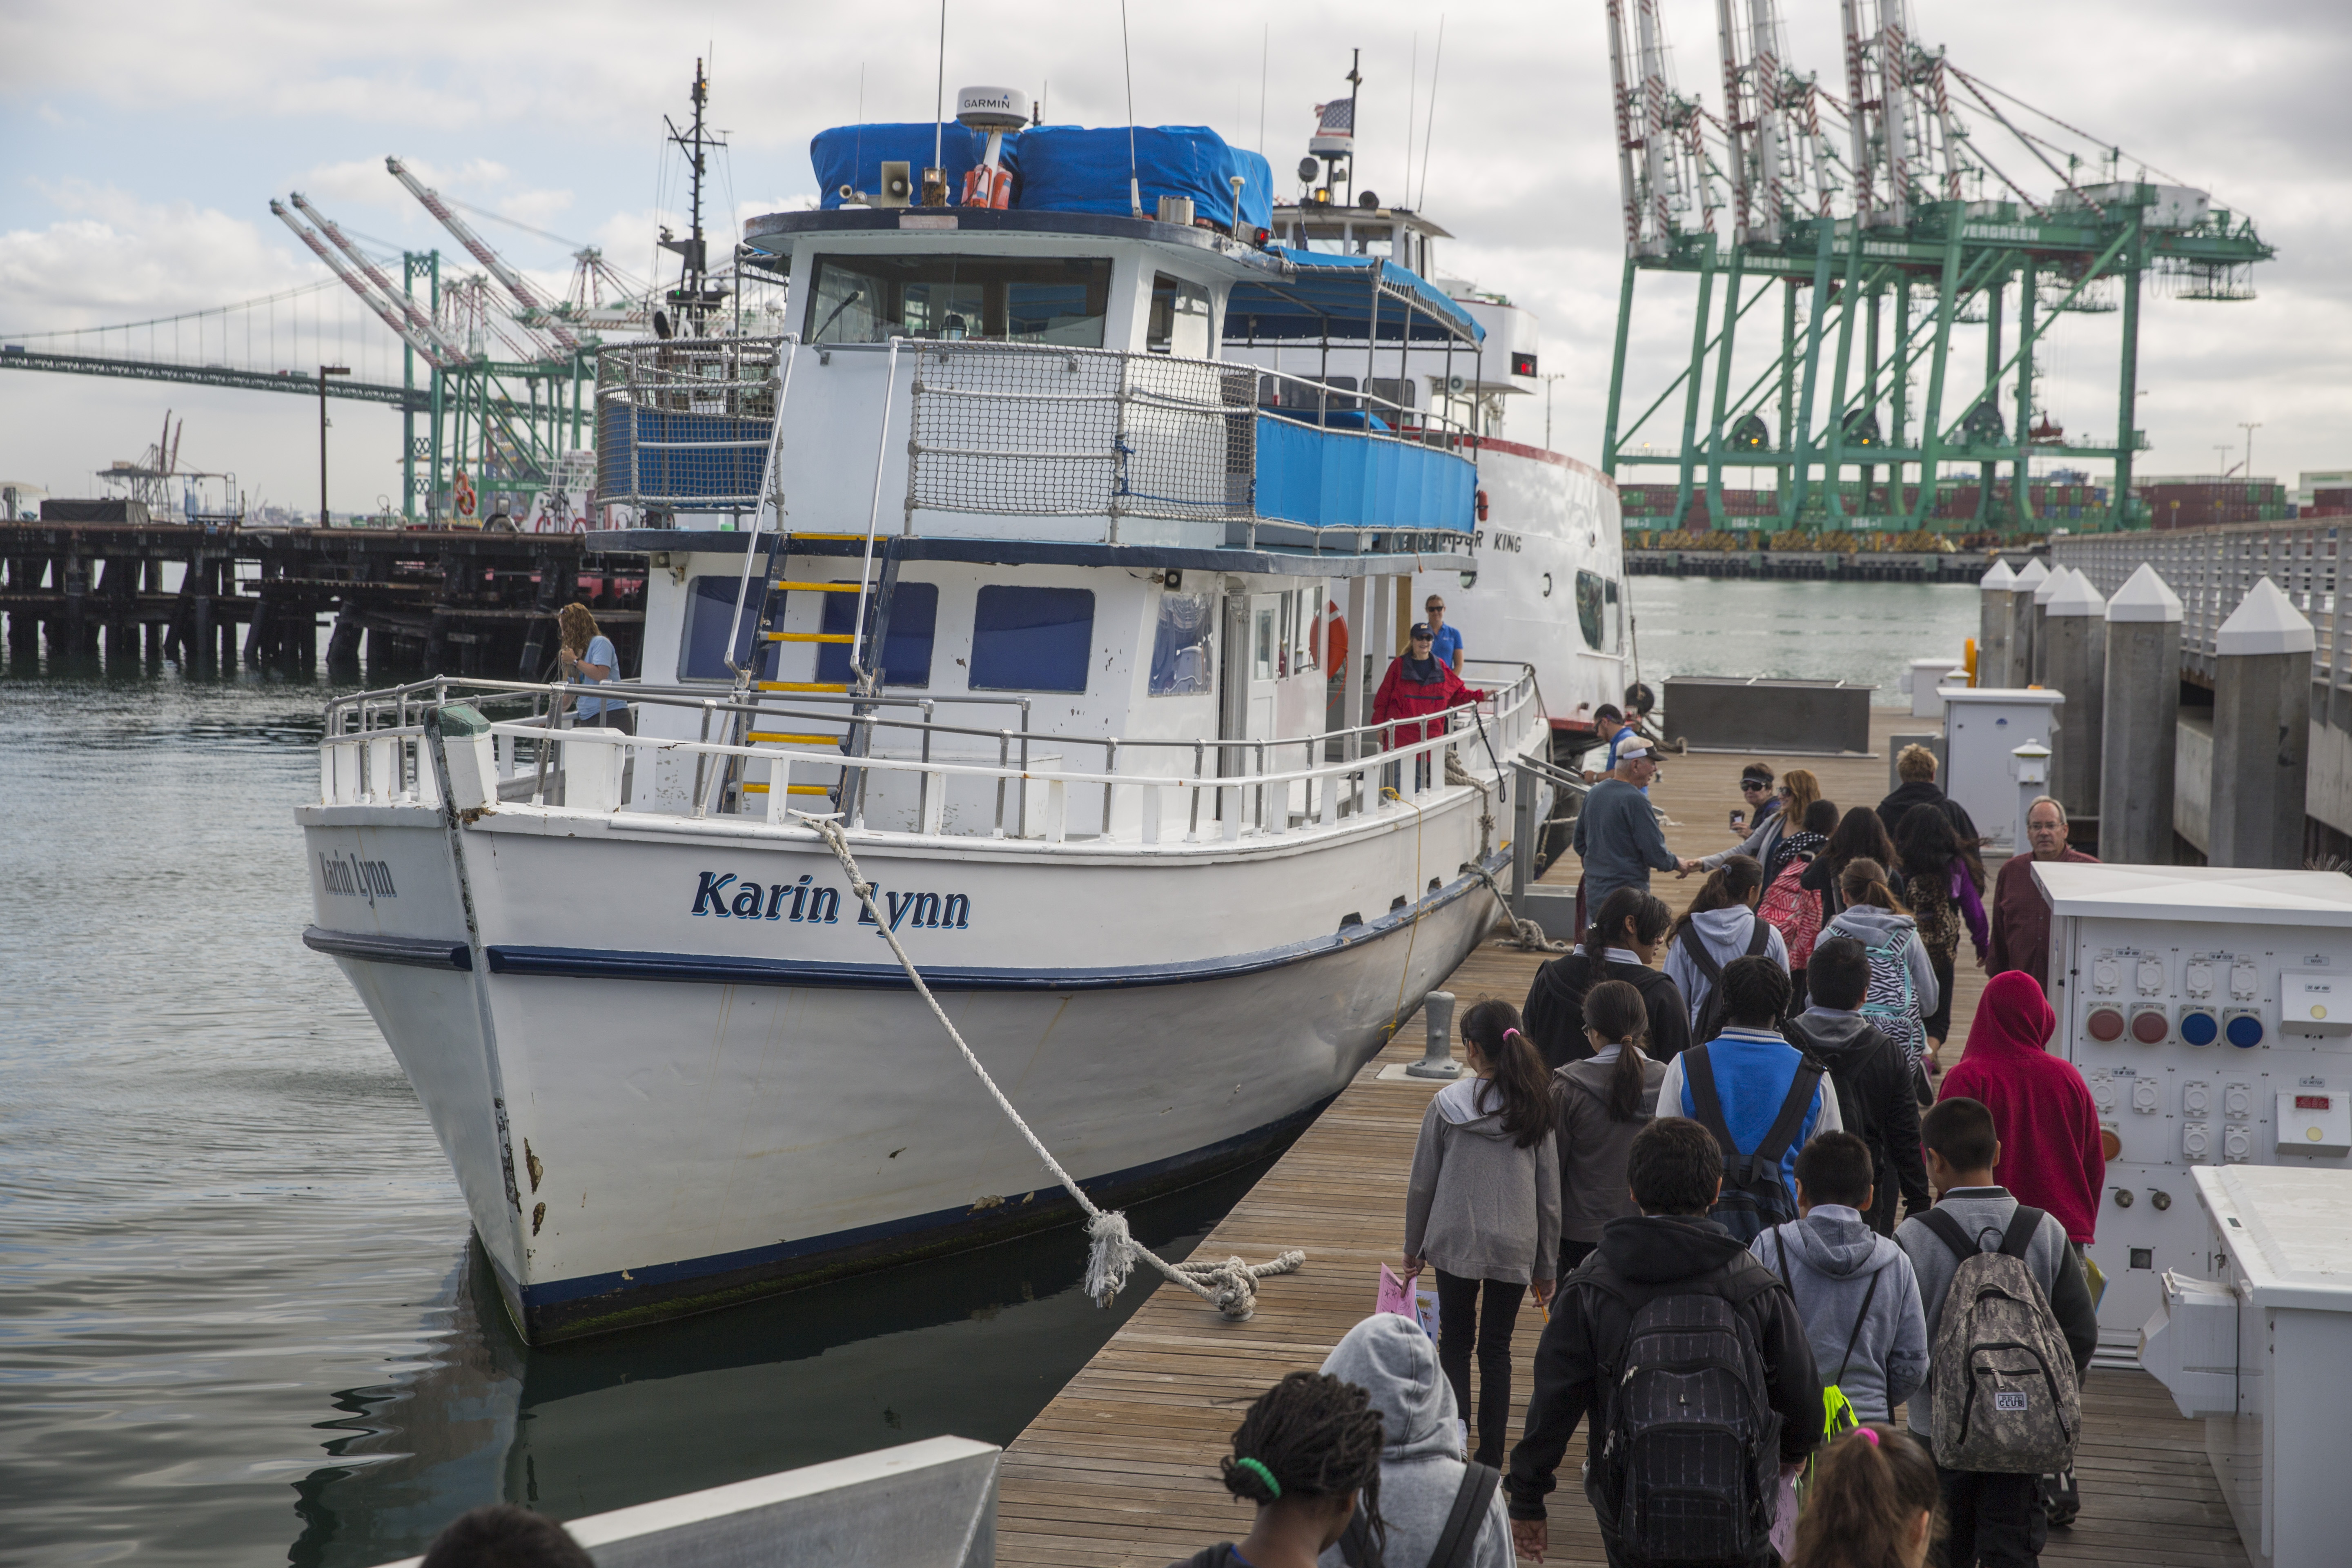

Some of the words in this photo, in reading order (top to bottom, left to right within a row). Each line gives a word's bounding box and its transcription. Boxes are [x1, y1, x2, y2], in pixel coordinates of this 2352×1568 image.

[964, 99, 1010, 109] GARMIN
[1961, 225, 2039, 241] VERGREEN
[494, 365, 539, 373] EVERGREEN
[1494, 532, 1522, 553] KING
[319, 849, 356, 897] Karin
[350, 853, 397, 909] Lynn
[691, 871, 840, 924] Karin
[858, 882, 971, 938] Lynn
